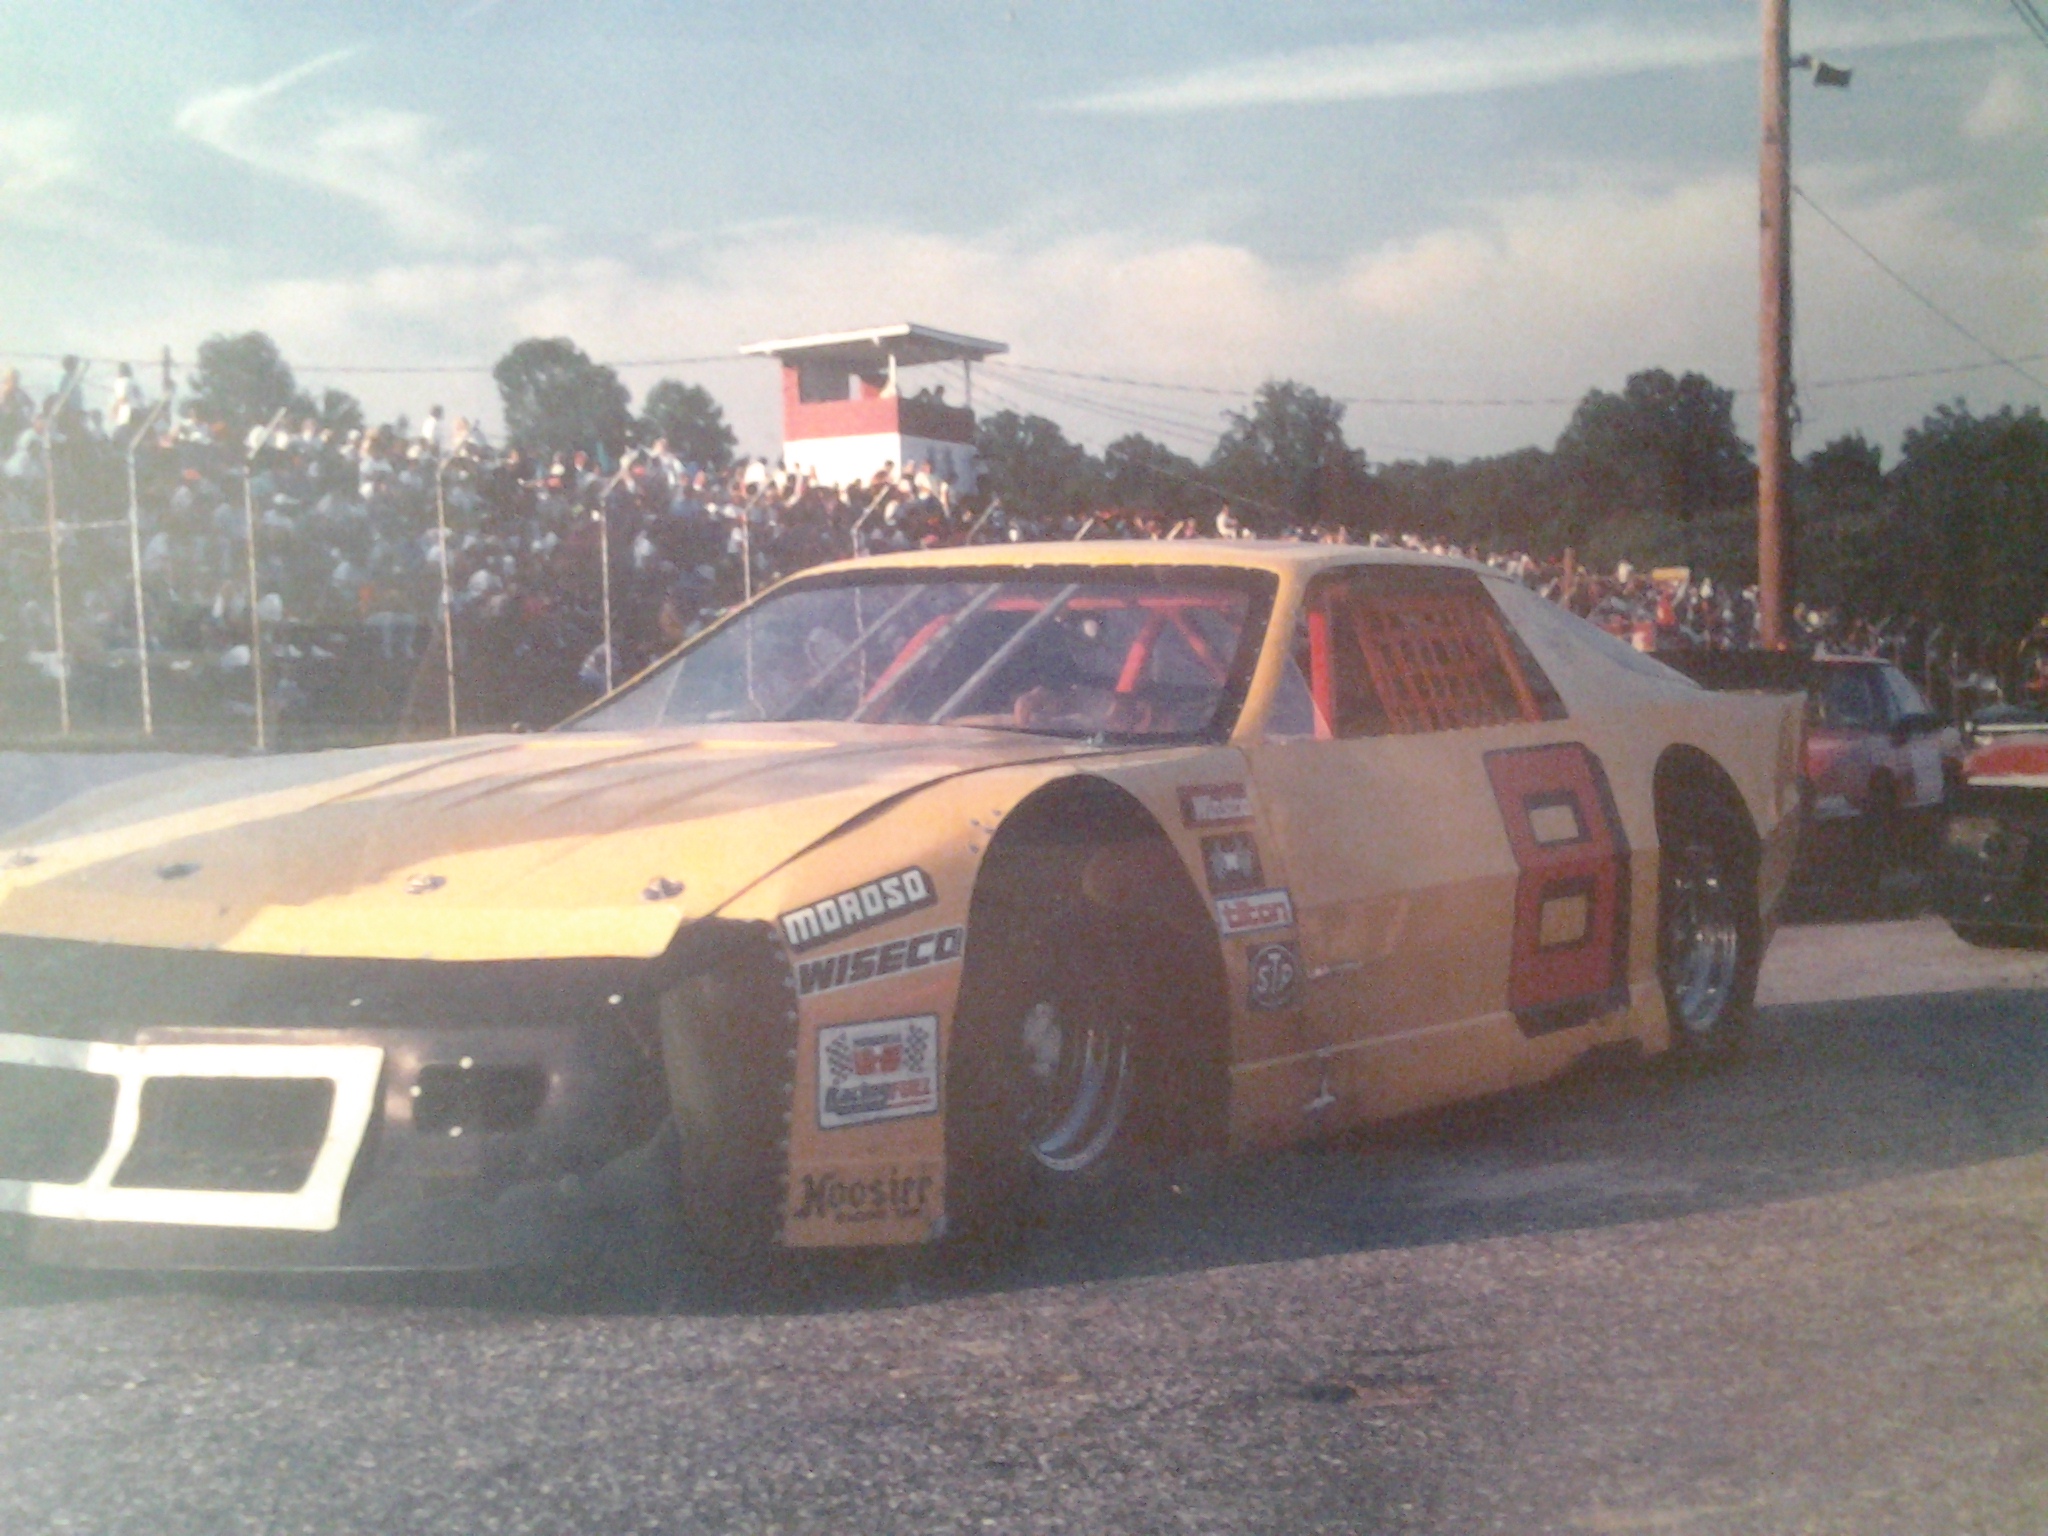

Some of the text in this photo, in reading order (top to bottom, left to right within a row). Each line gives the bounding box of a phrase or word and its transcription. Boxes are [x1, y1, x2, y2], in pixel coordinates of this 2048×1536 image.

[782, 867, 930, 947] MOROSO
[1484, 741, 1631, 1036] 8
[799, 926, 962, 994] WISECO
